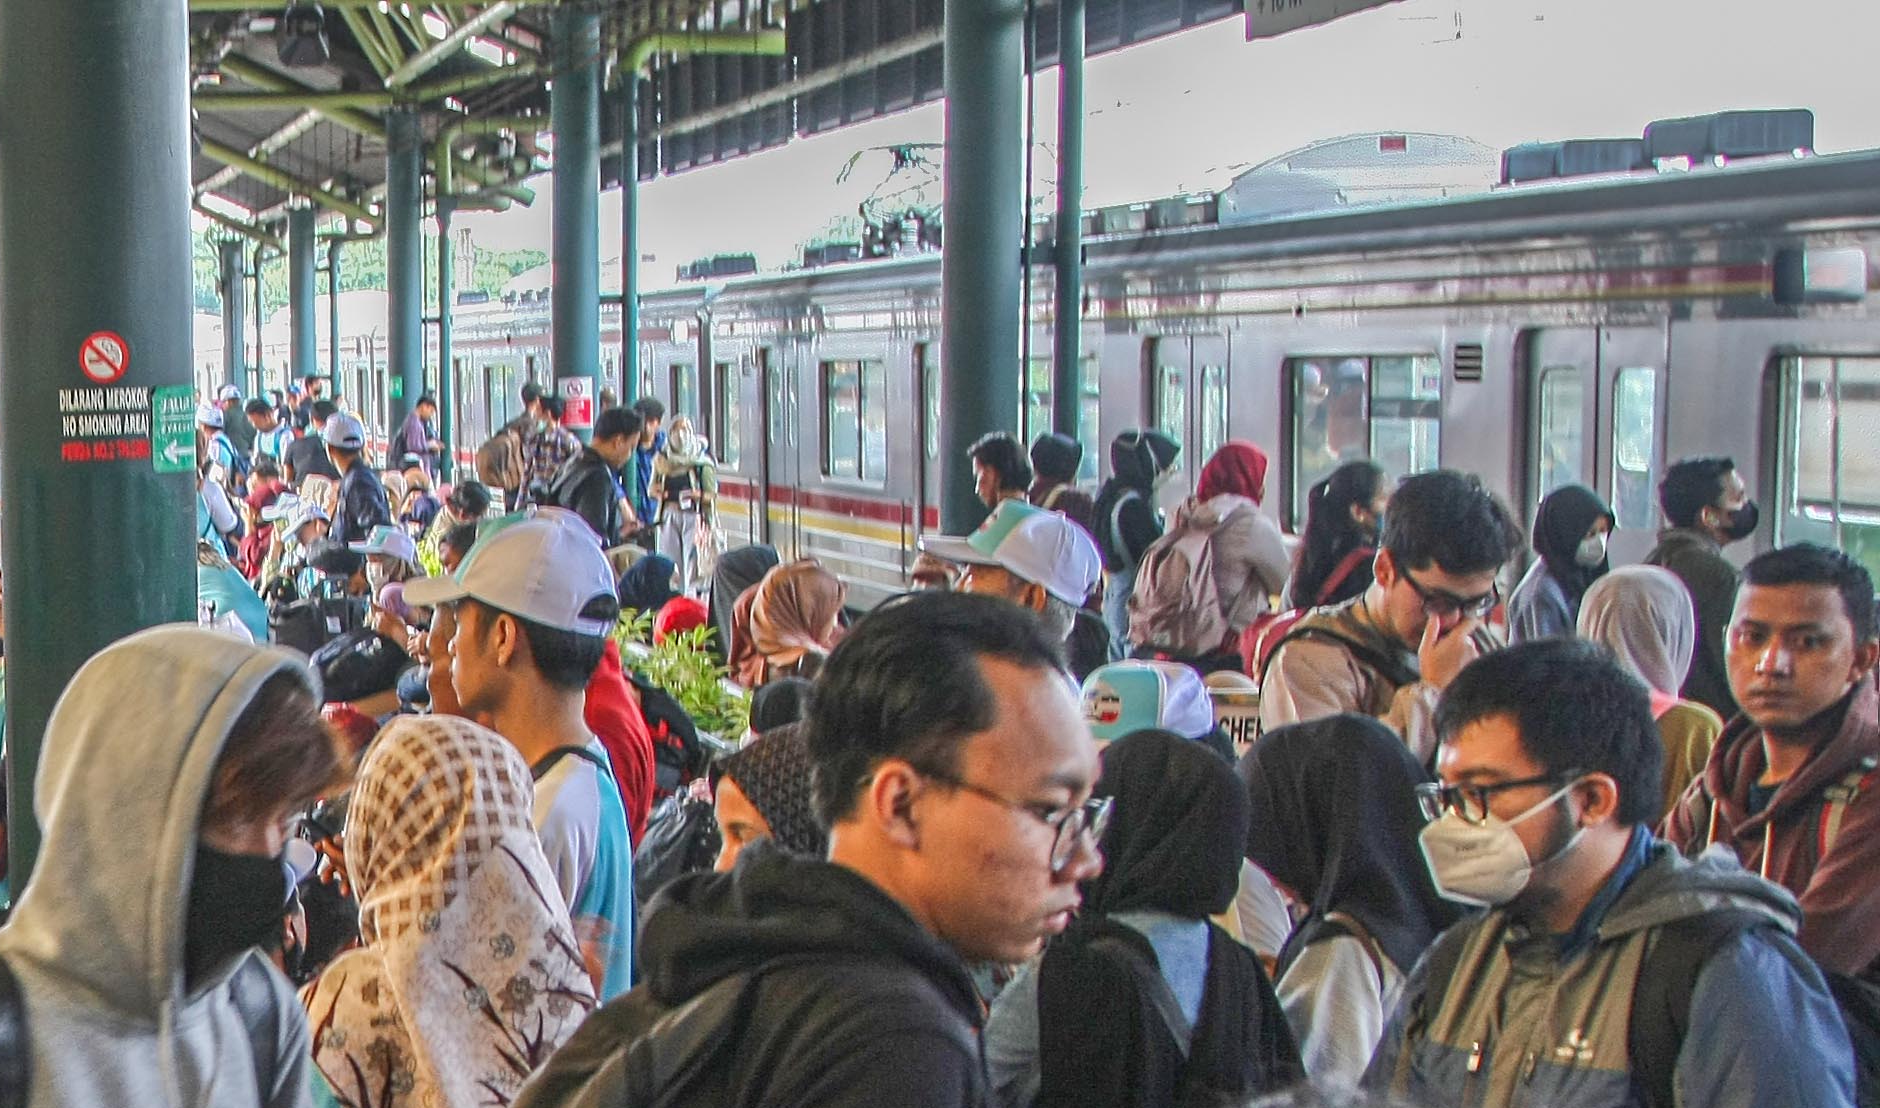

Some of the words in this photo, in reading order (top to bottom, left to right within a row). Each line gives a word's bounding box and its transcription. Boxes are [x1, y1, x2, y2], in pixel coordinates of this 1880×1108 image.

[59, 388, 104, 412] DILARANG
[106, 387, 149, 411] MEROKOK
[63, 415, 77, 437] NO
[79, 414, 122, 437] SMOKING
